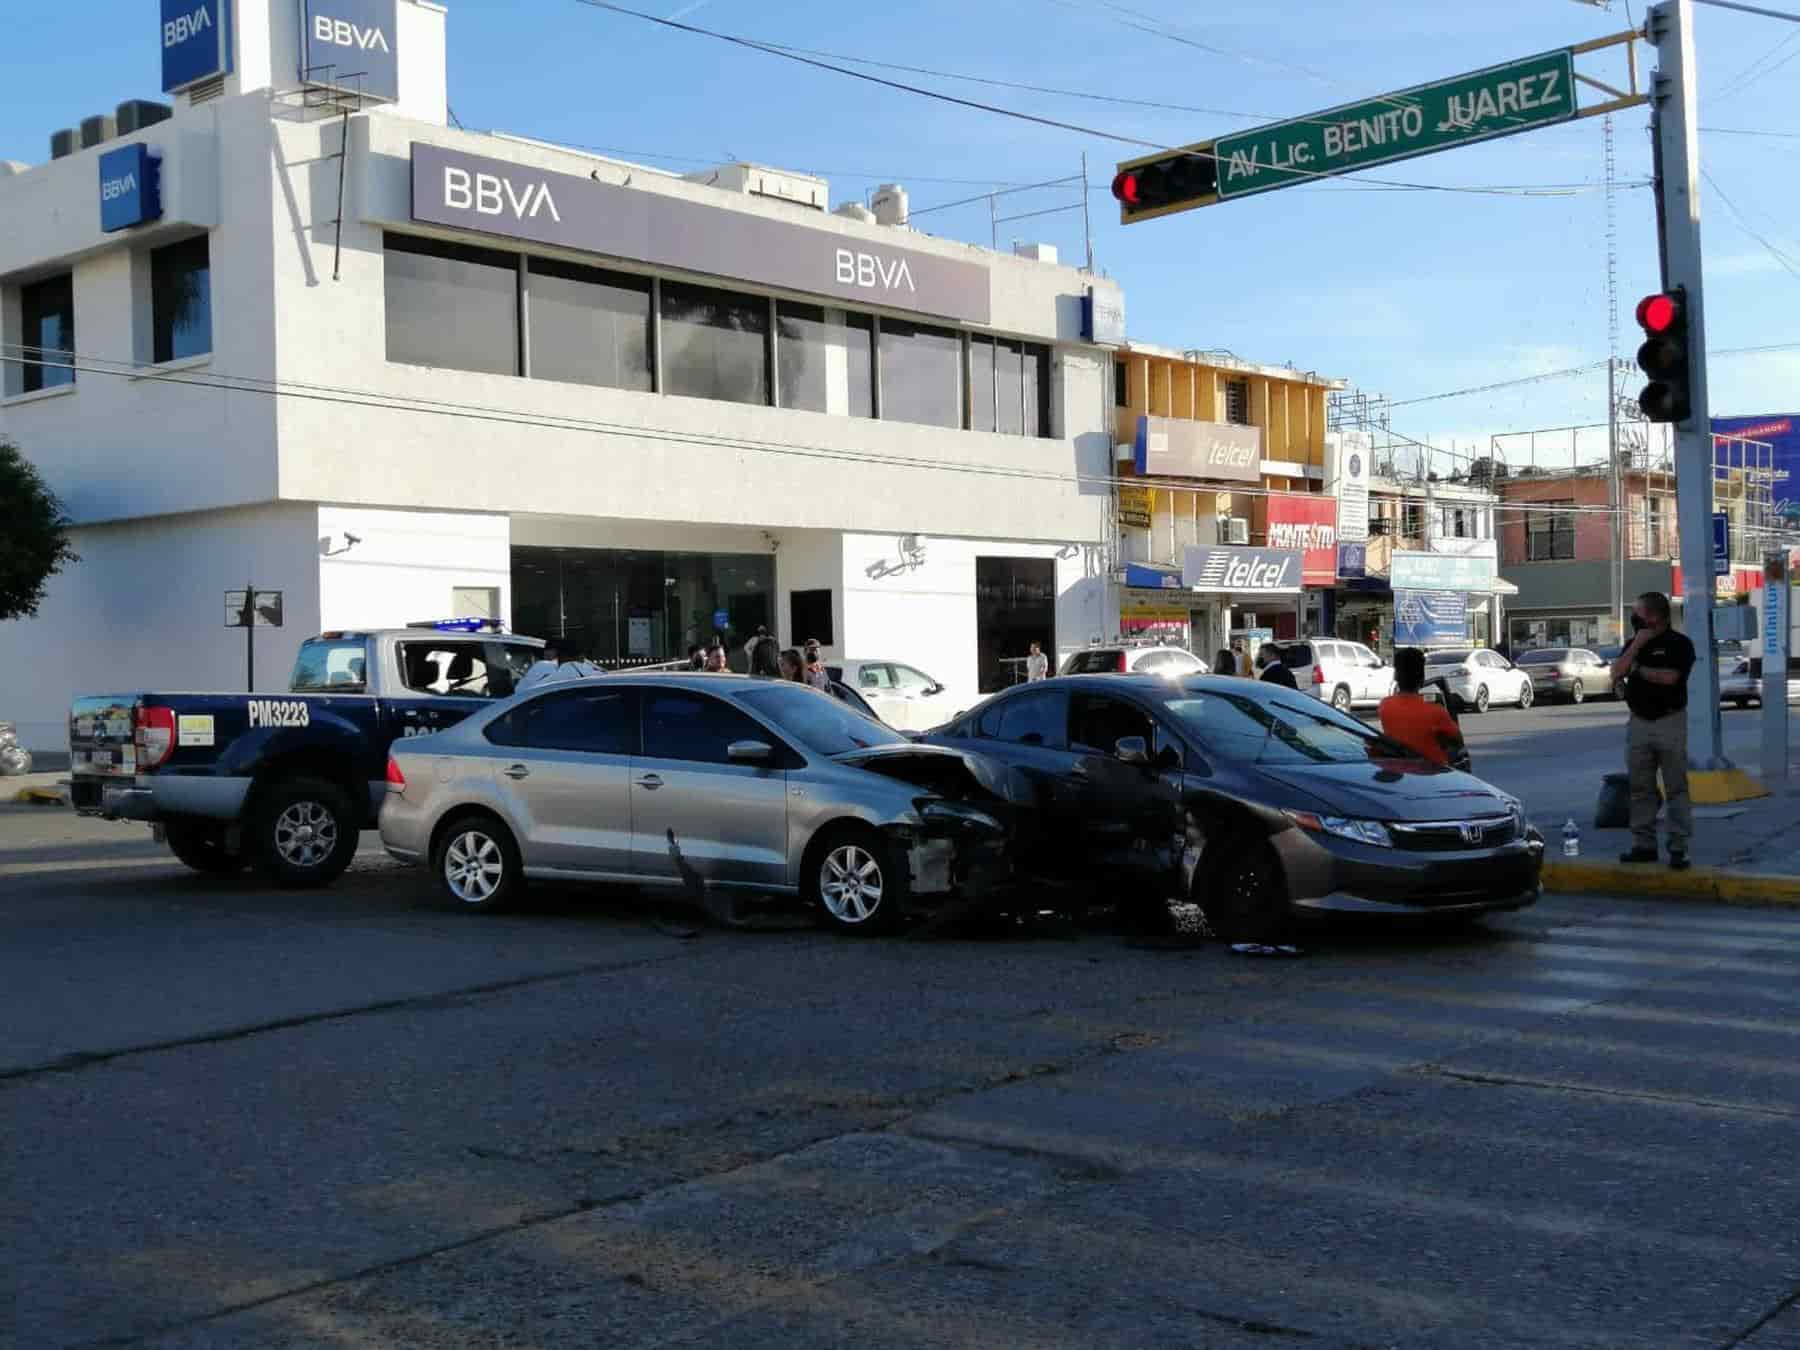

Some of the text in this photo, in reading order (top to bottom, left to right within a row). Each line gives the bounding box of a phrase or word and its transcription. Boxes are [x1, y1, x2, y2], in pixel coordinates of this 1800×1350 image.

[164, 7, 213, 48] BBVA
[315, 15, 390, 54] BBVA
[1228, 144, 1260, 180] AV.
[1323, 106, 1423, 157] BENITO
[1434, 69, 1563, 132] JUAREZ
[102, 171, 137, 201] BBVA
[444, 165, 562, 223] BBVA
[835, 248, 916, 292] BBVA
[1207, 439, 1256, 466] telcel
[1222, 554, 1290, 588] telcel
[248, 700, 310, 728] PM3223
